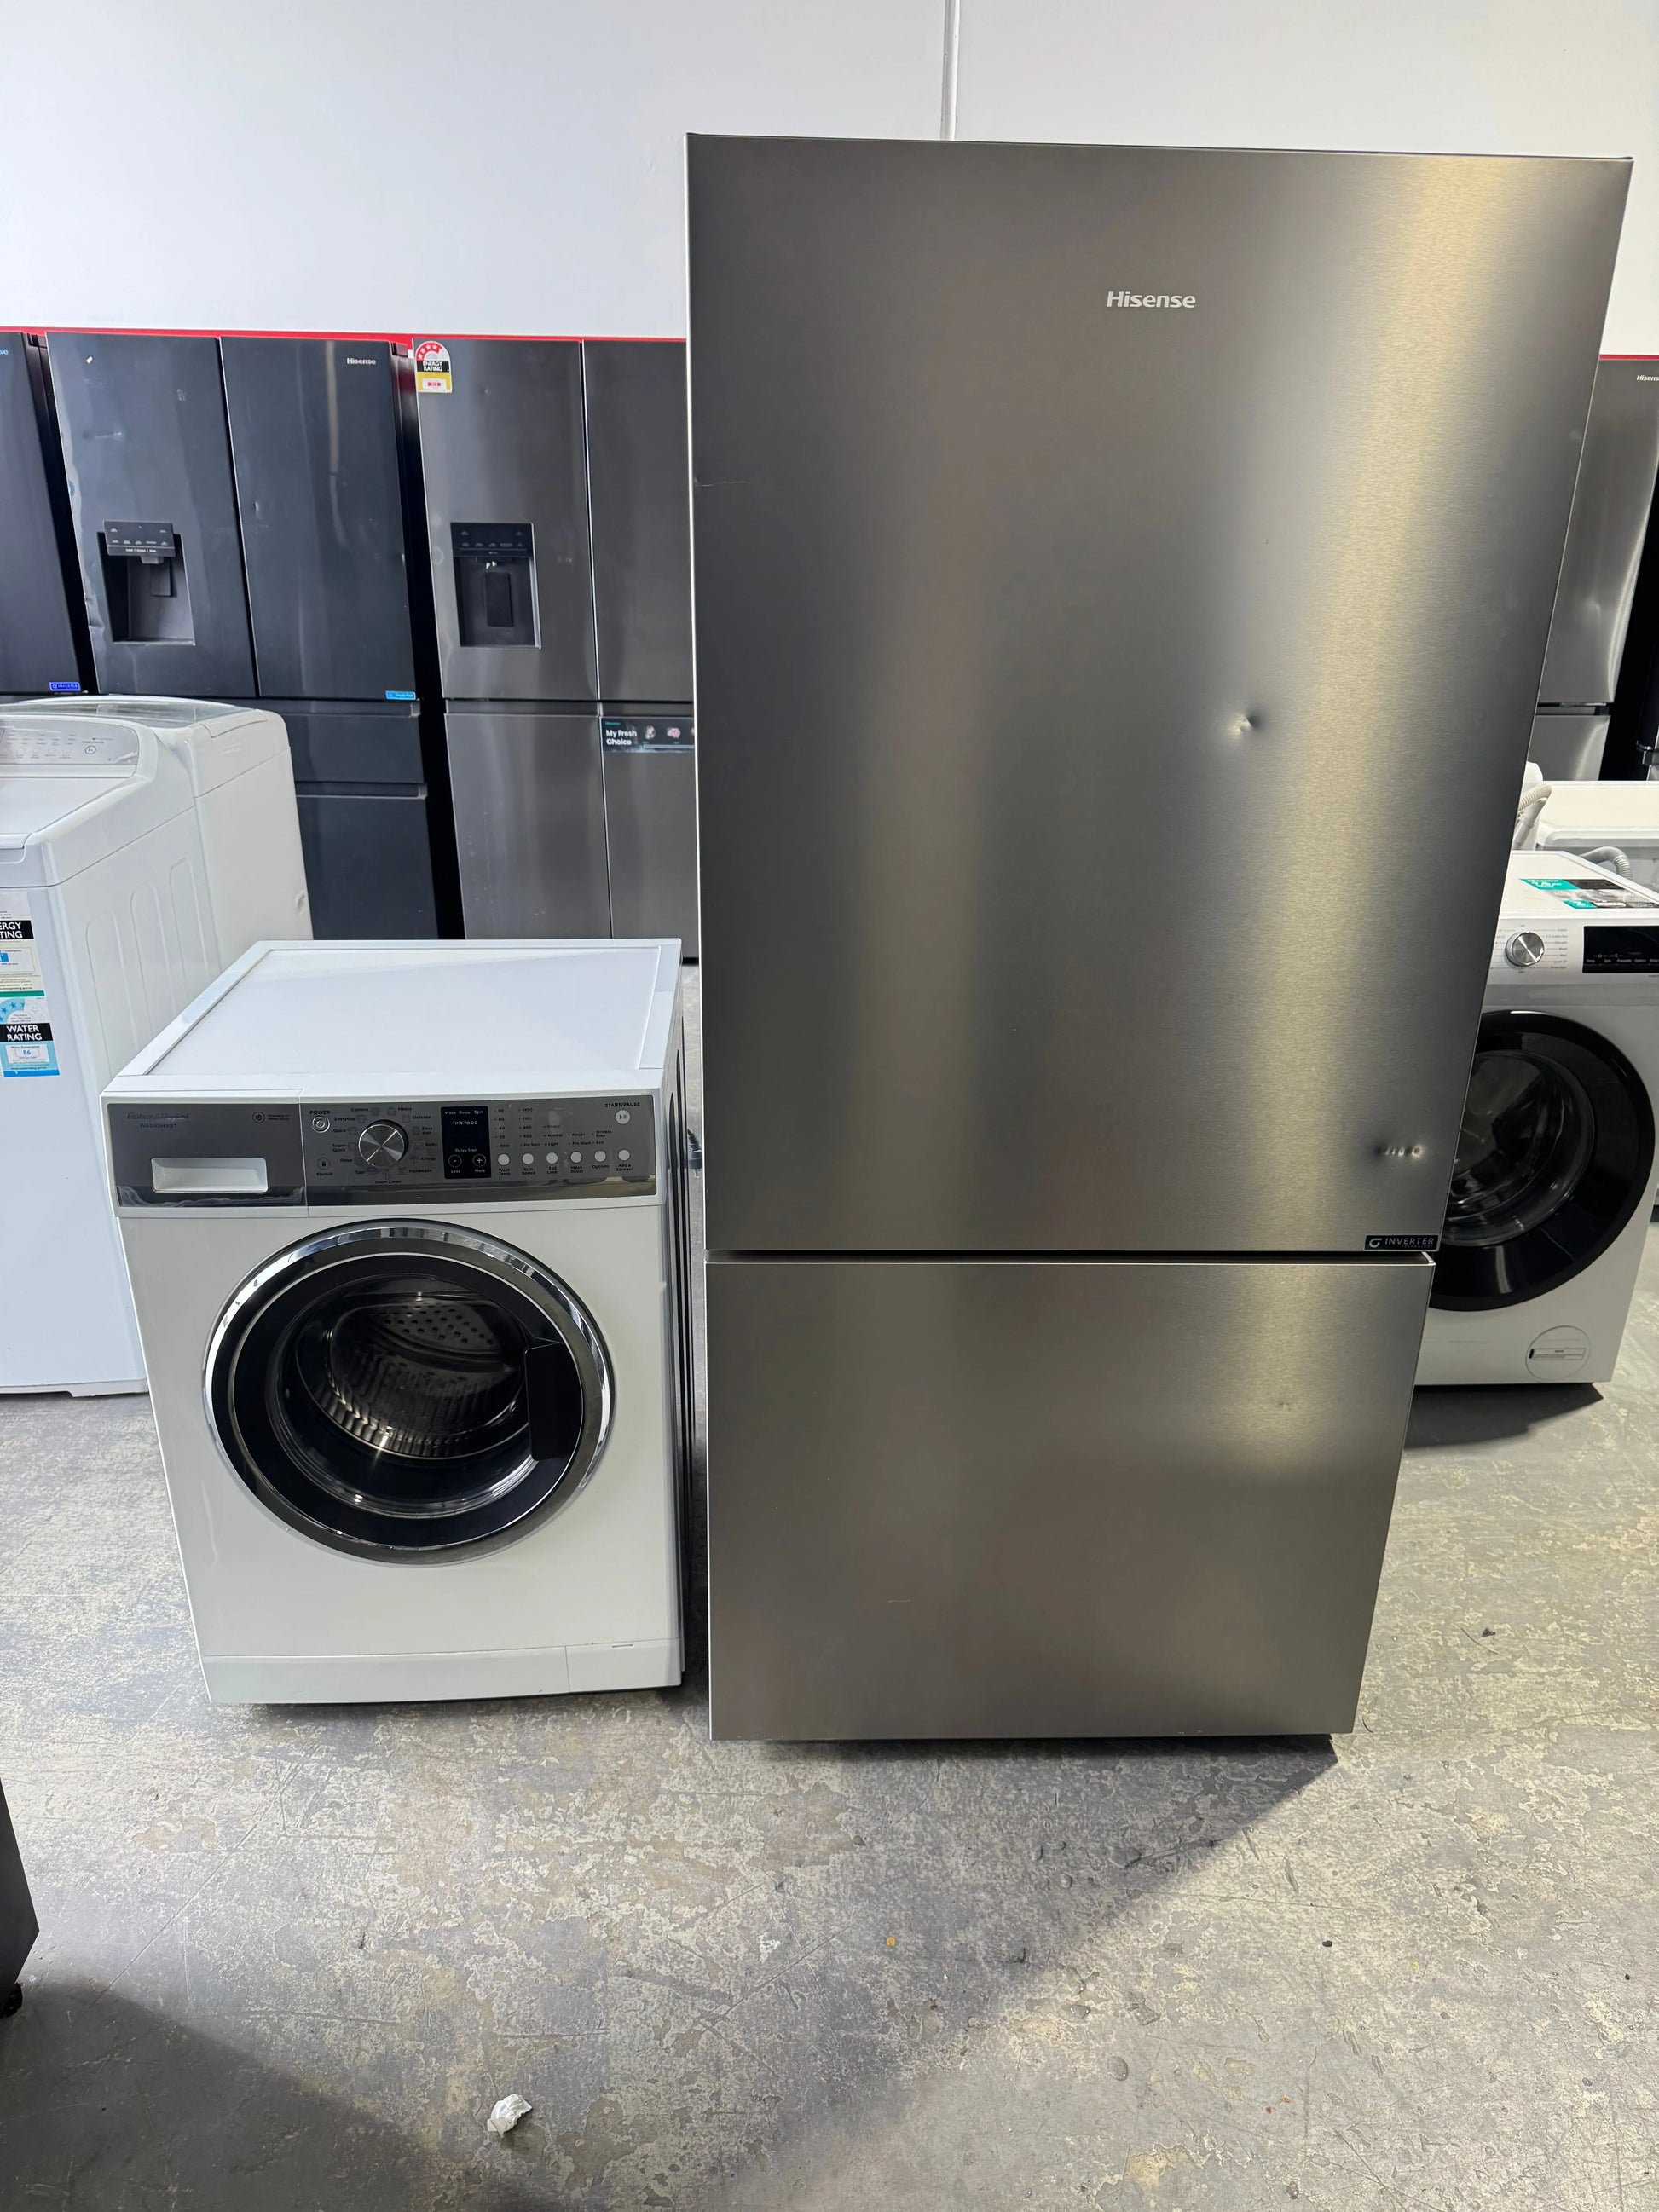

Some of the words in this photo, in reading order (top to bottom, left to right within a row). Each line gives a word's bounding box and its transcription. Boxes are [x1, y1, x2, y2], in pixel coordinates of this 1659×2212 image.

[1107, 291, 1196, 309] Hisense
[6, 1024, 40, 1033] WATER
[6, 1032, 43, 1042] RATING
